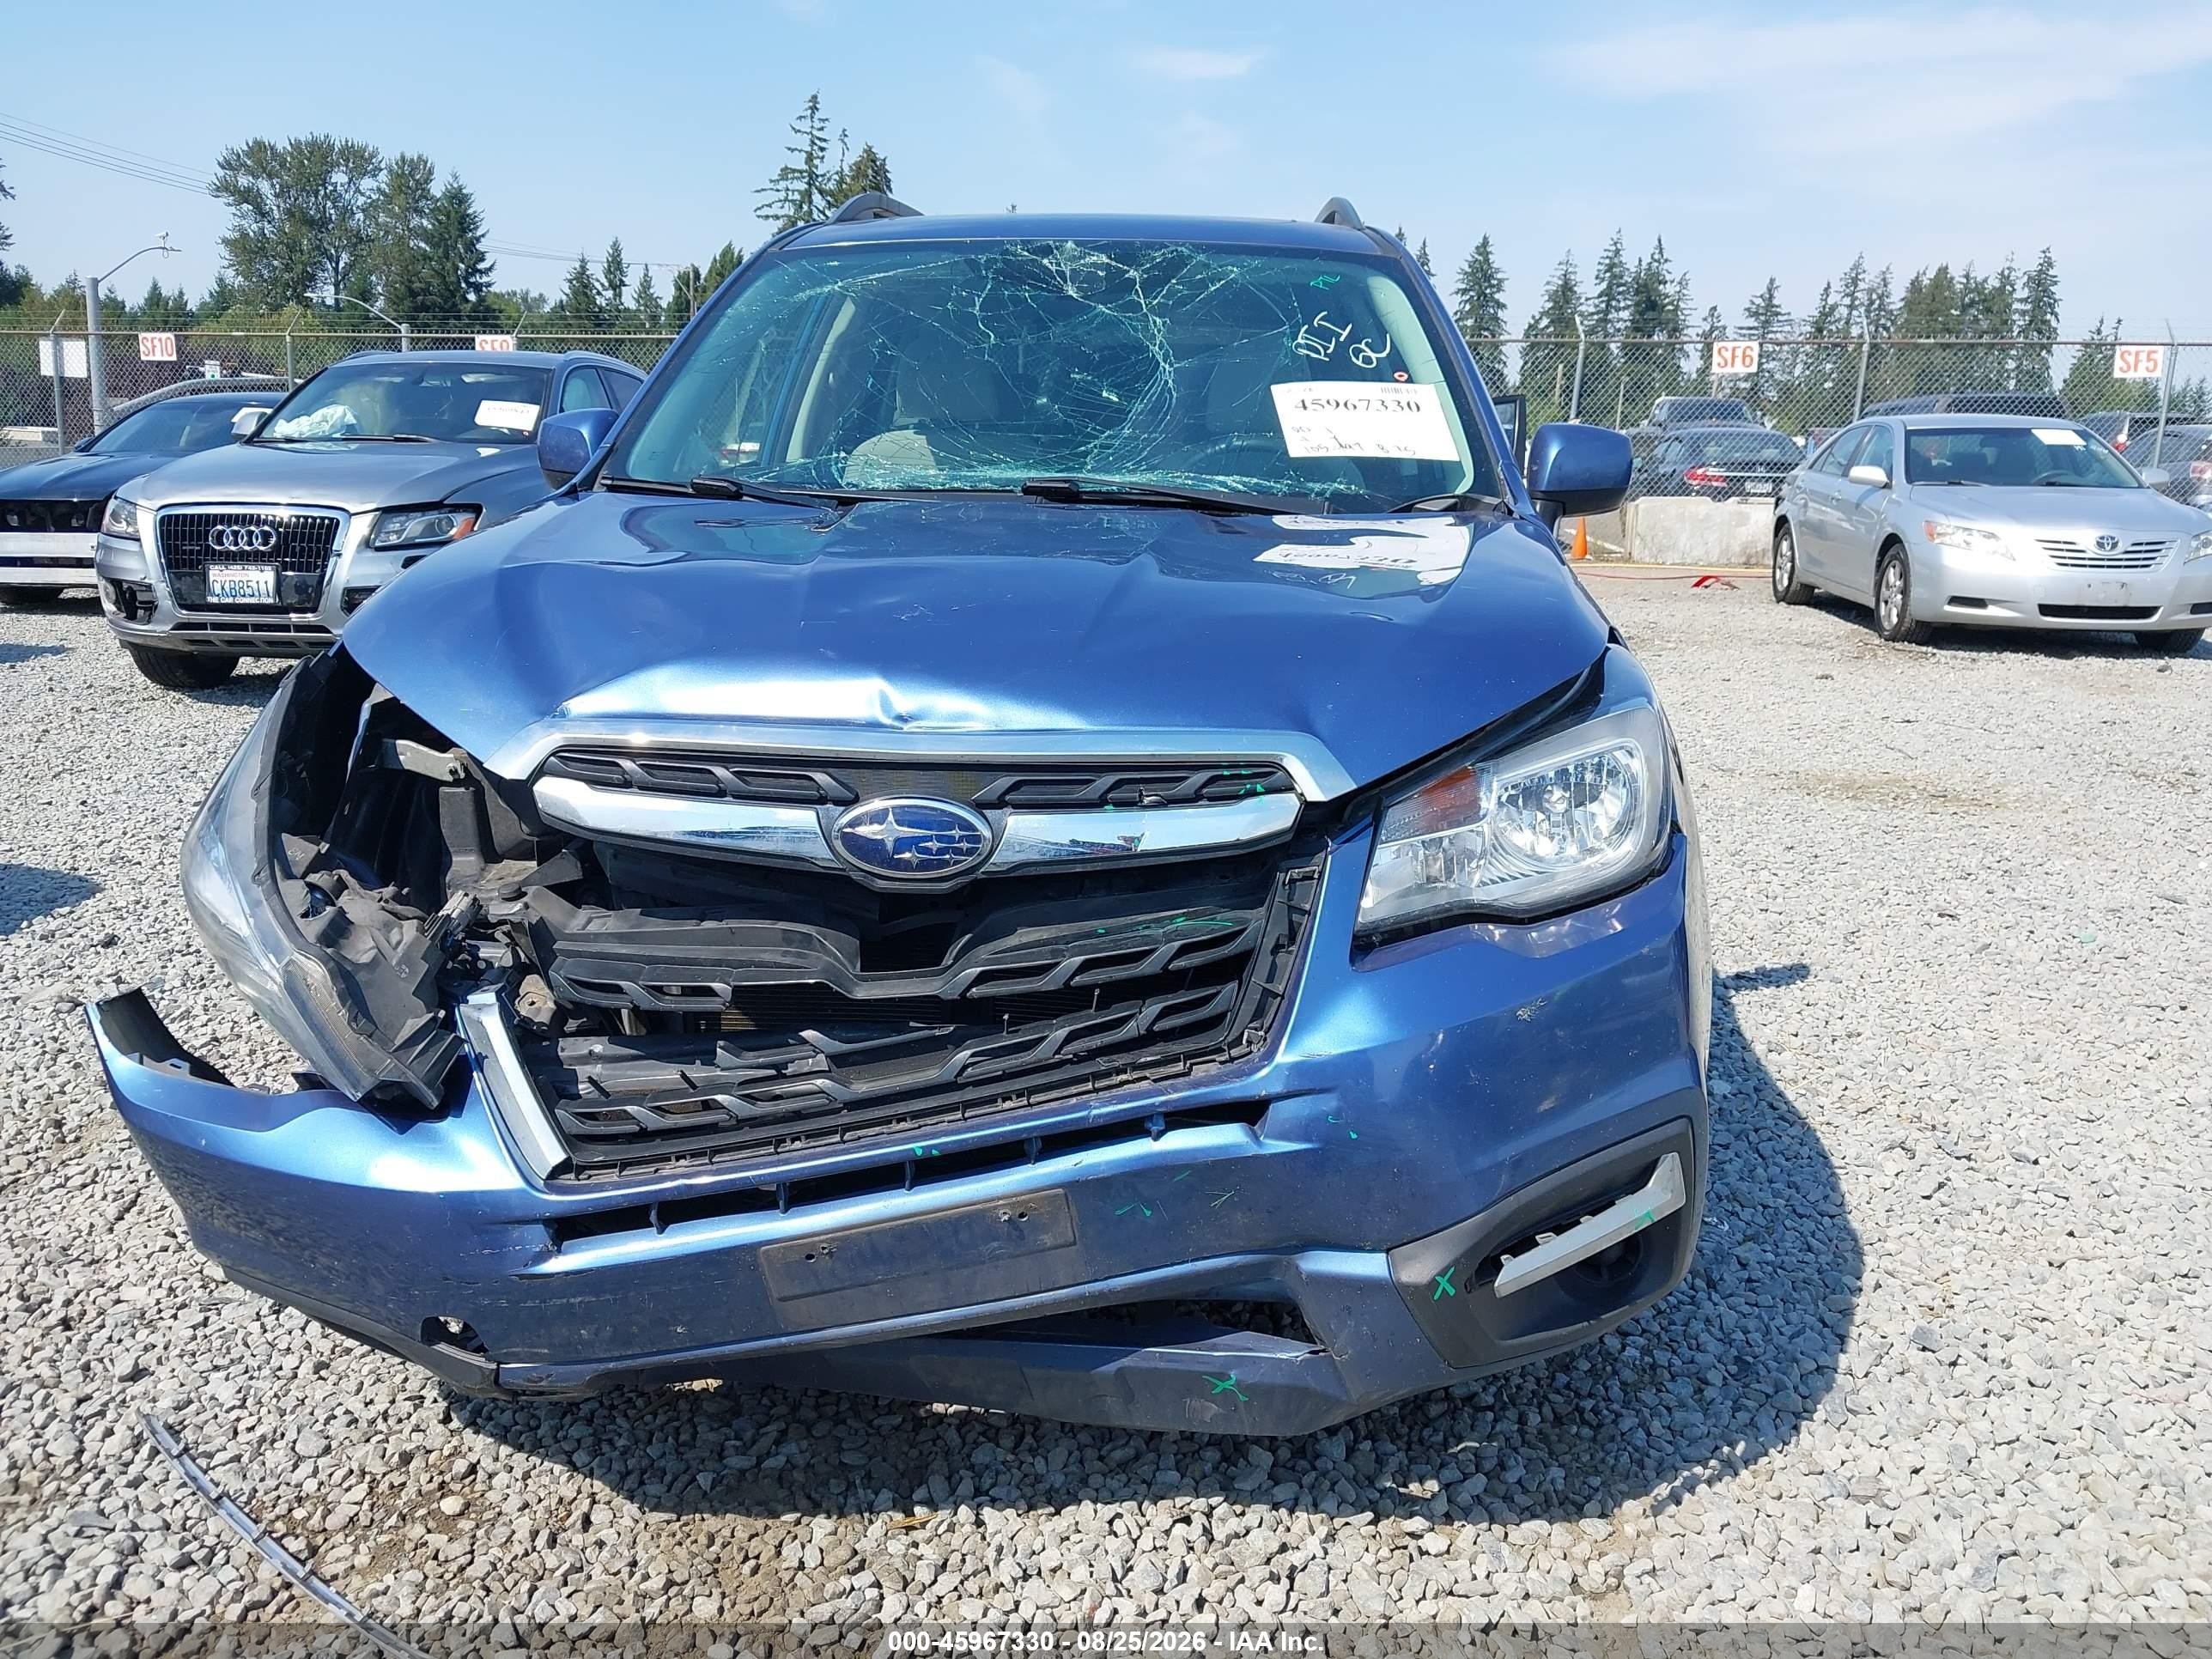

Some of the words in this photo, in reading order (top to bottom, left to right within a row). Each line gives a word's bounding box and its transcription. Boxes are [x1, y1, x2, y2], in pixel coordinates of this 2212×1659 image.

[141, 336, 174, 357] SF10
[1717, 345, 1754, 368] SF6
[2118, 349, 2159, 374] SF5
[1294, 398, 1421, 413] 45967330
[211, 579, 271, 598] CKB8511
